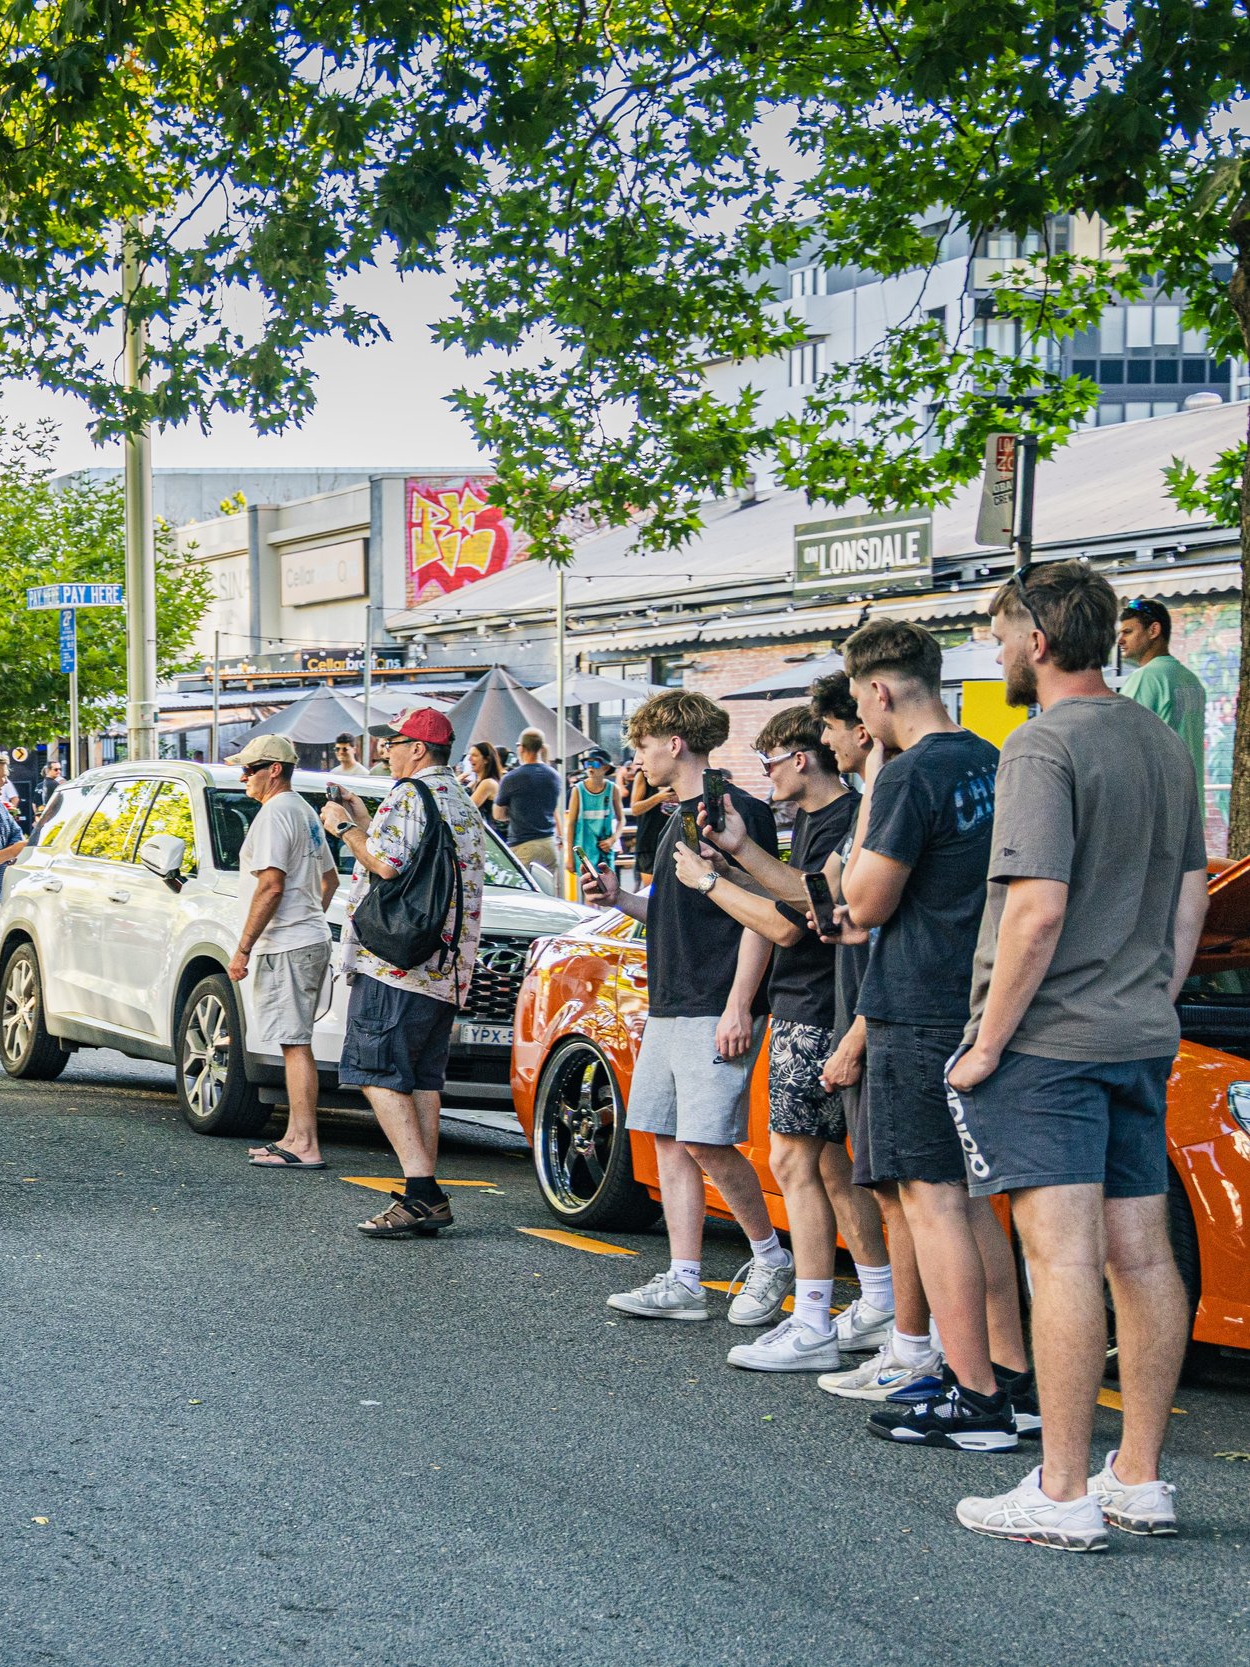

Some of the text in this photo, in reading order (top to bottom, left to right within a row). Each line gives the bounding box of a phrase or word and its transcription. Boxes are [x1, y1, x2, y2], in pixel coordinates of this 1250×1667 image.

[803, 531, 920, 576] ON LONSDALE
[63, 586, 119, 604] PAY HERE
